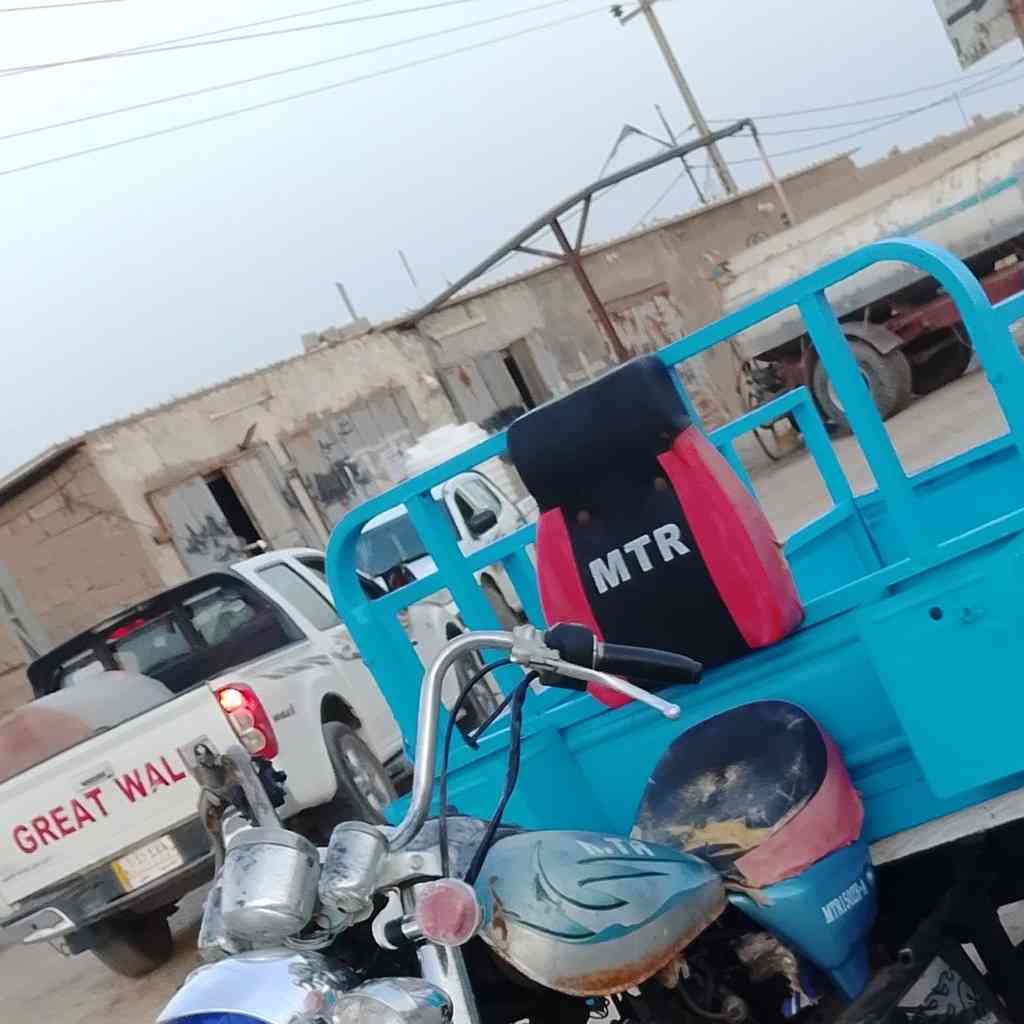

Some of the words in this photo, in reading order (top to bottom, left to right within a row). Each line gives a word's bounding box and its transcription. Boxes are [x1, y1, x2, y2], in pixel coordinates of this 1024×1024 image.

[588, 523, 691, 594] MTR
[13, 787, 108, 854] GREAT
[114, 754, 189, 803] WAL
